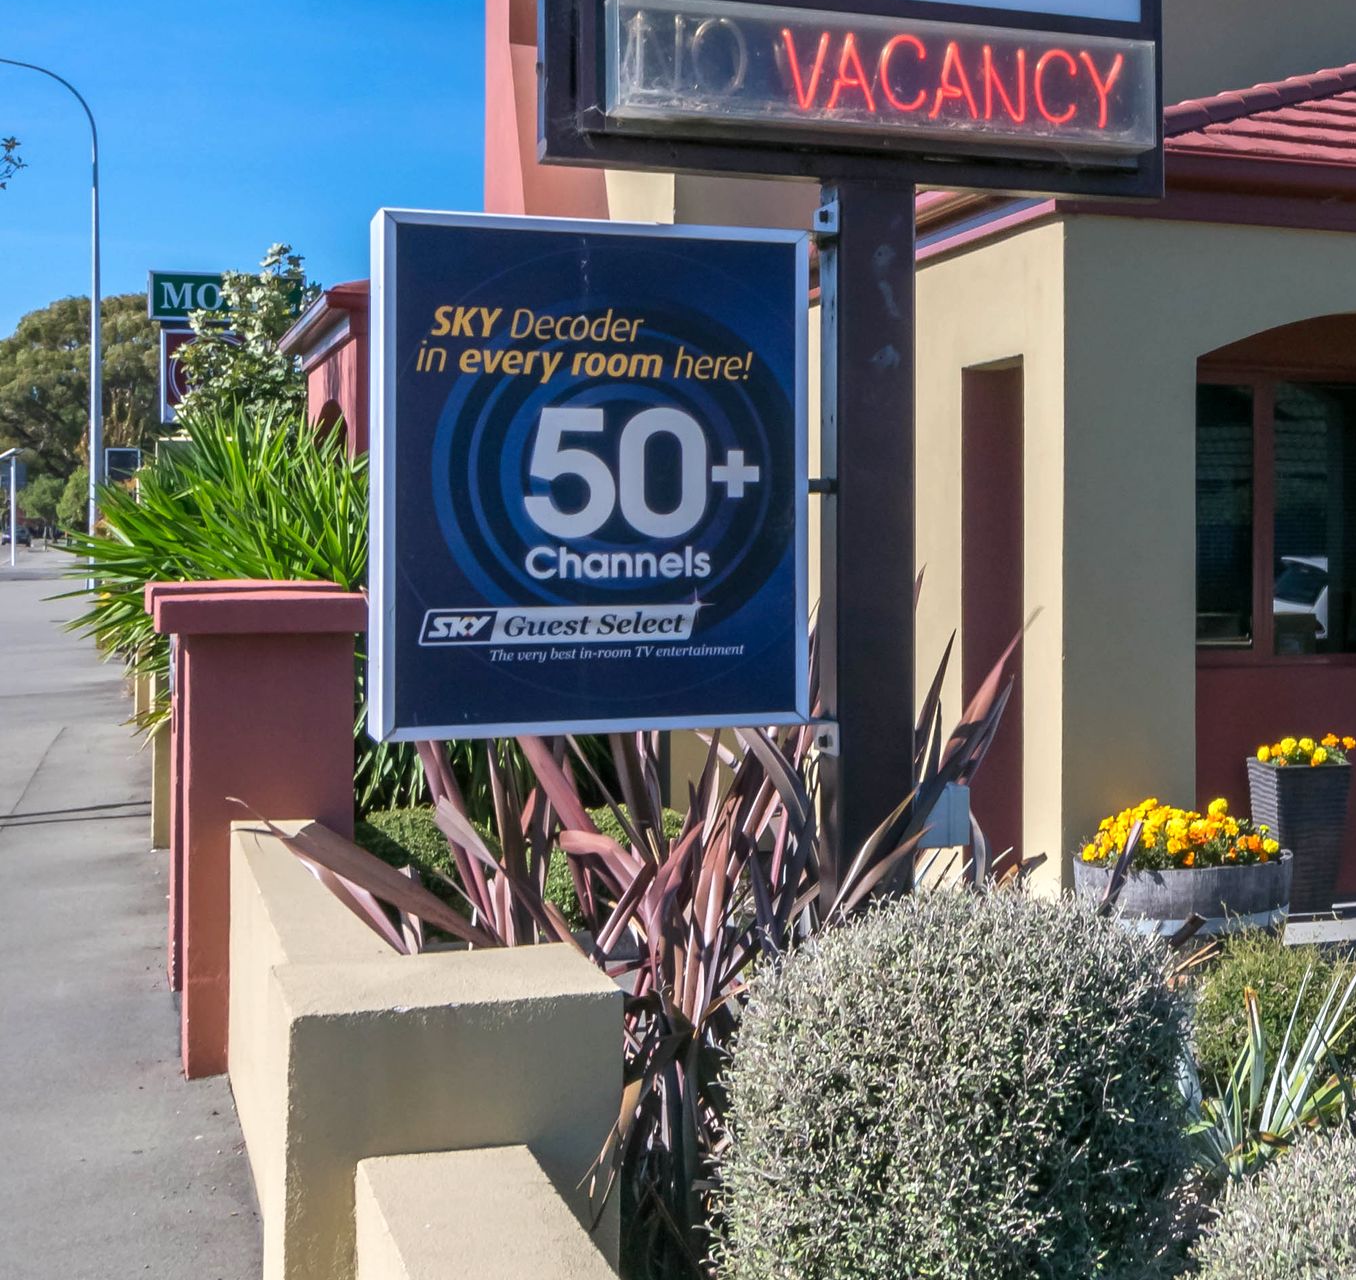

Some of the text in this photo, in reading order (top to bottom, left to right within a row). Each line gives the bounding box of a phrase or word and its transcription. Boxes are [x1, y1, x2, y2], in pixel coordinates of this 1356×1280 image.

[782, 28, 1124, 128] VACANCY
[431, 305, 645, 342] SKY Decoder
[416, 339, 753, 384] in every room here!
[524, 407, 760, 539] 50+
[525, 545, 712, 580] Channels
[428, 611, 686, 638] SKY Guest Select
[490, 643, 744, 663] The very best in-room TV entertainment
